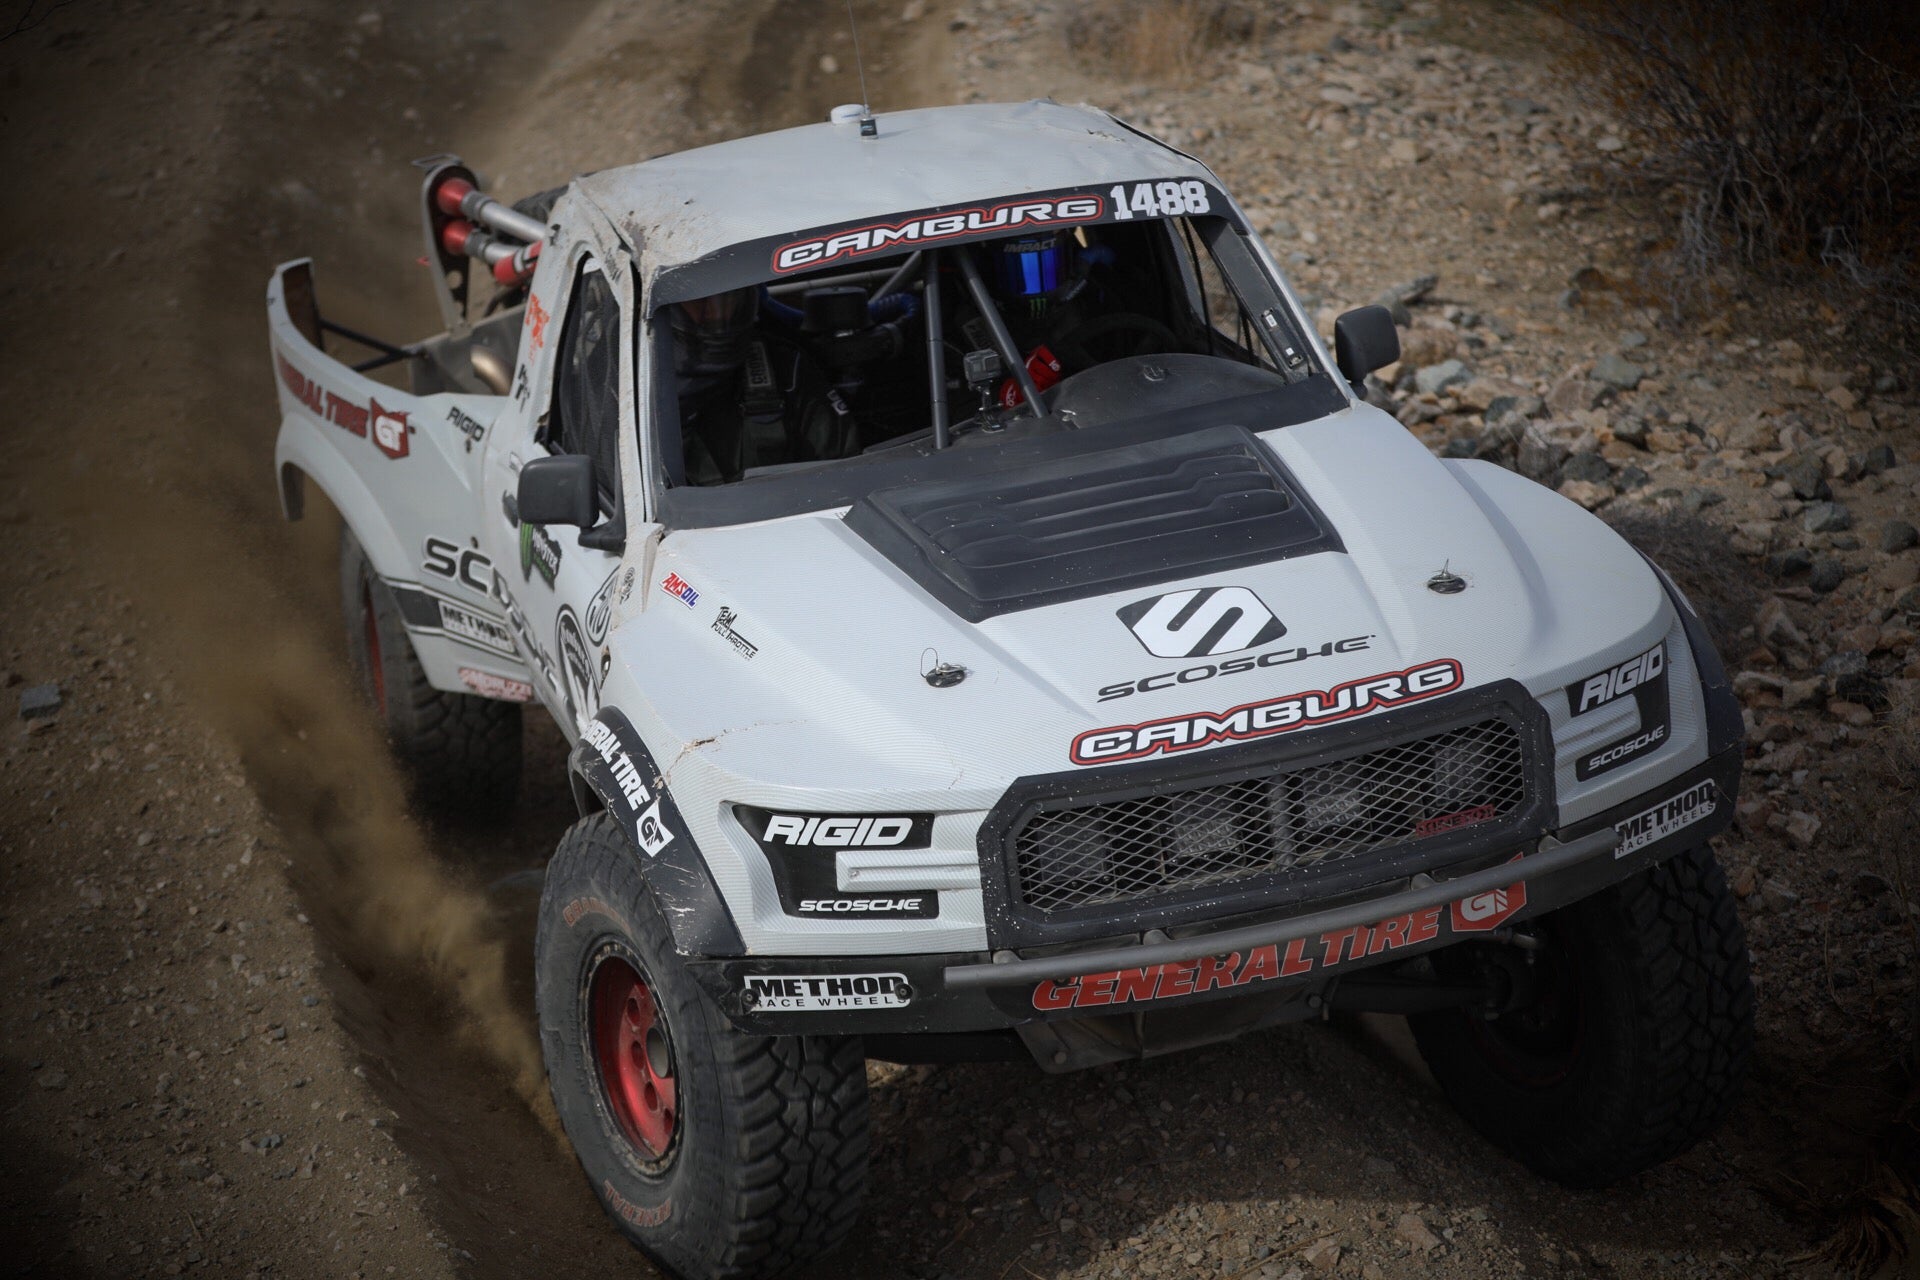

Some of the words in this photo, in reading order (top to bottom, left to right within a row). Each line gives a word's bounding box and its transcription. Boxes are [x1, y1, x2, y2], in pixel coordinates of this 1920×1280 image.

[1109, 180, 1211, 220] 1488
[776, 197, 1099, 271] CAMBURG
[446, 406, 485, 442] RIGID
[661, 571, 700, 608] AMSOIL
[711, 620, 730, 638] FULL
[726, 628, 758, 659] THROTTLE
[1097, 635, 1371, 703] SCOSCHE
[1578, 643, 1664, 713] RIGID
[1077, 662, 1457, 760] CAMBURG
[1587, 724, 1665, 771] SCOSCHE
[609, 752, 651, 811] TIRE
[762, 815, 914, 846] RIGID
[1617, 830, 1653, 855] RACE
[1660, 801, 1715, 834] WHEELS
[798, 898, 923, 912] SCOSCHE
[1032, 938, 1315, 1011] GENERAL
[1320, 906, 1442, 967] TIRE
[749, 976, 905, 998] METHOD
